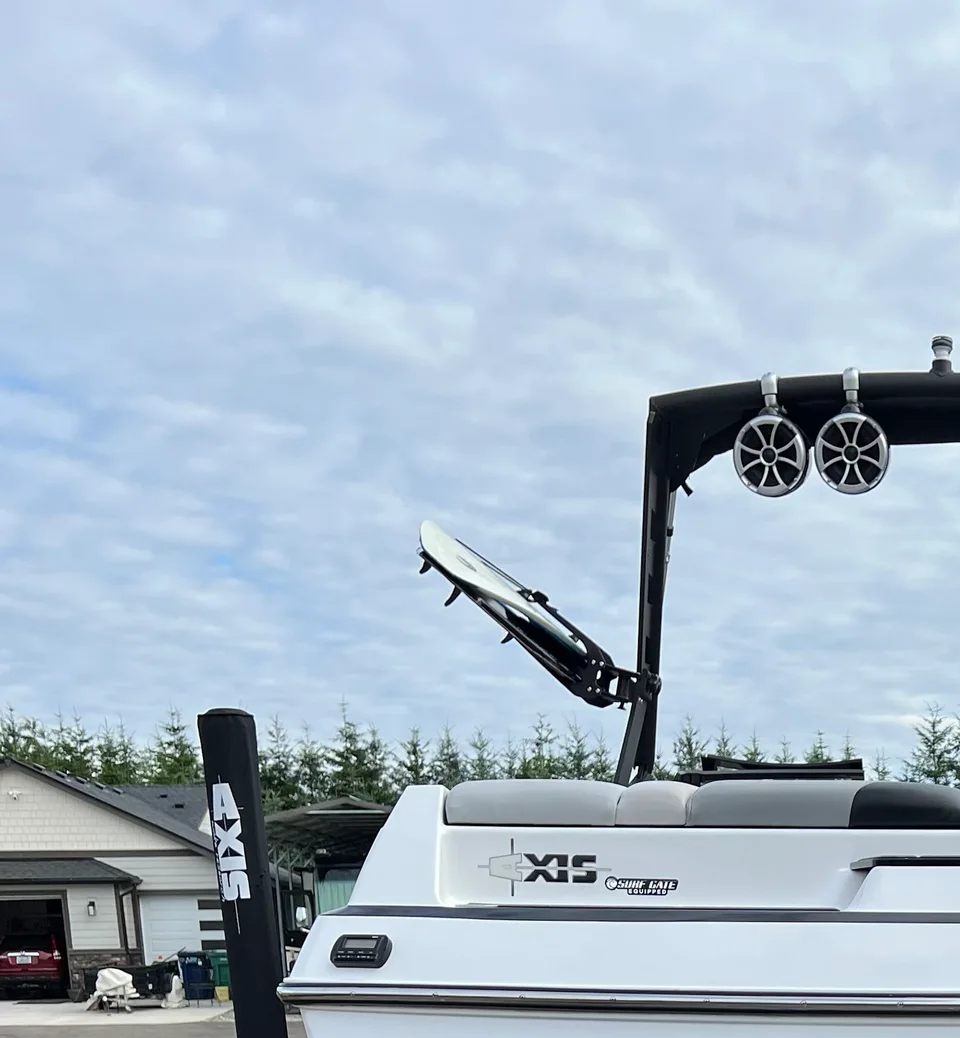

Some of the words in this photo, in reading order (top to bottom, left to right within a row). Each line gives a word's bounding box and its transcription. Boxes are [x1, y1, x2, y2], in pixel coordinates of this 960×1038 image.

[212, 782, 251, 901] AXIS
[617, 879, 647, 890] SURF
[648, 880, 676, 890] GATE
